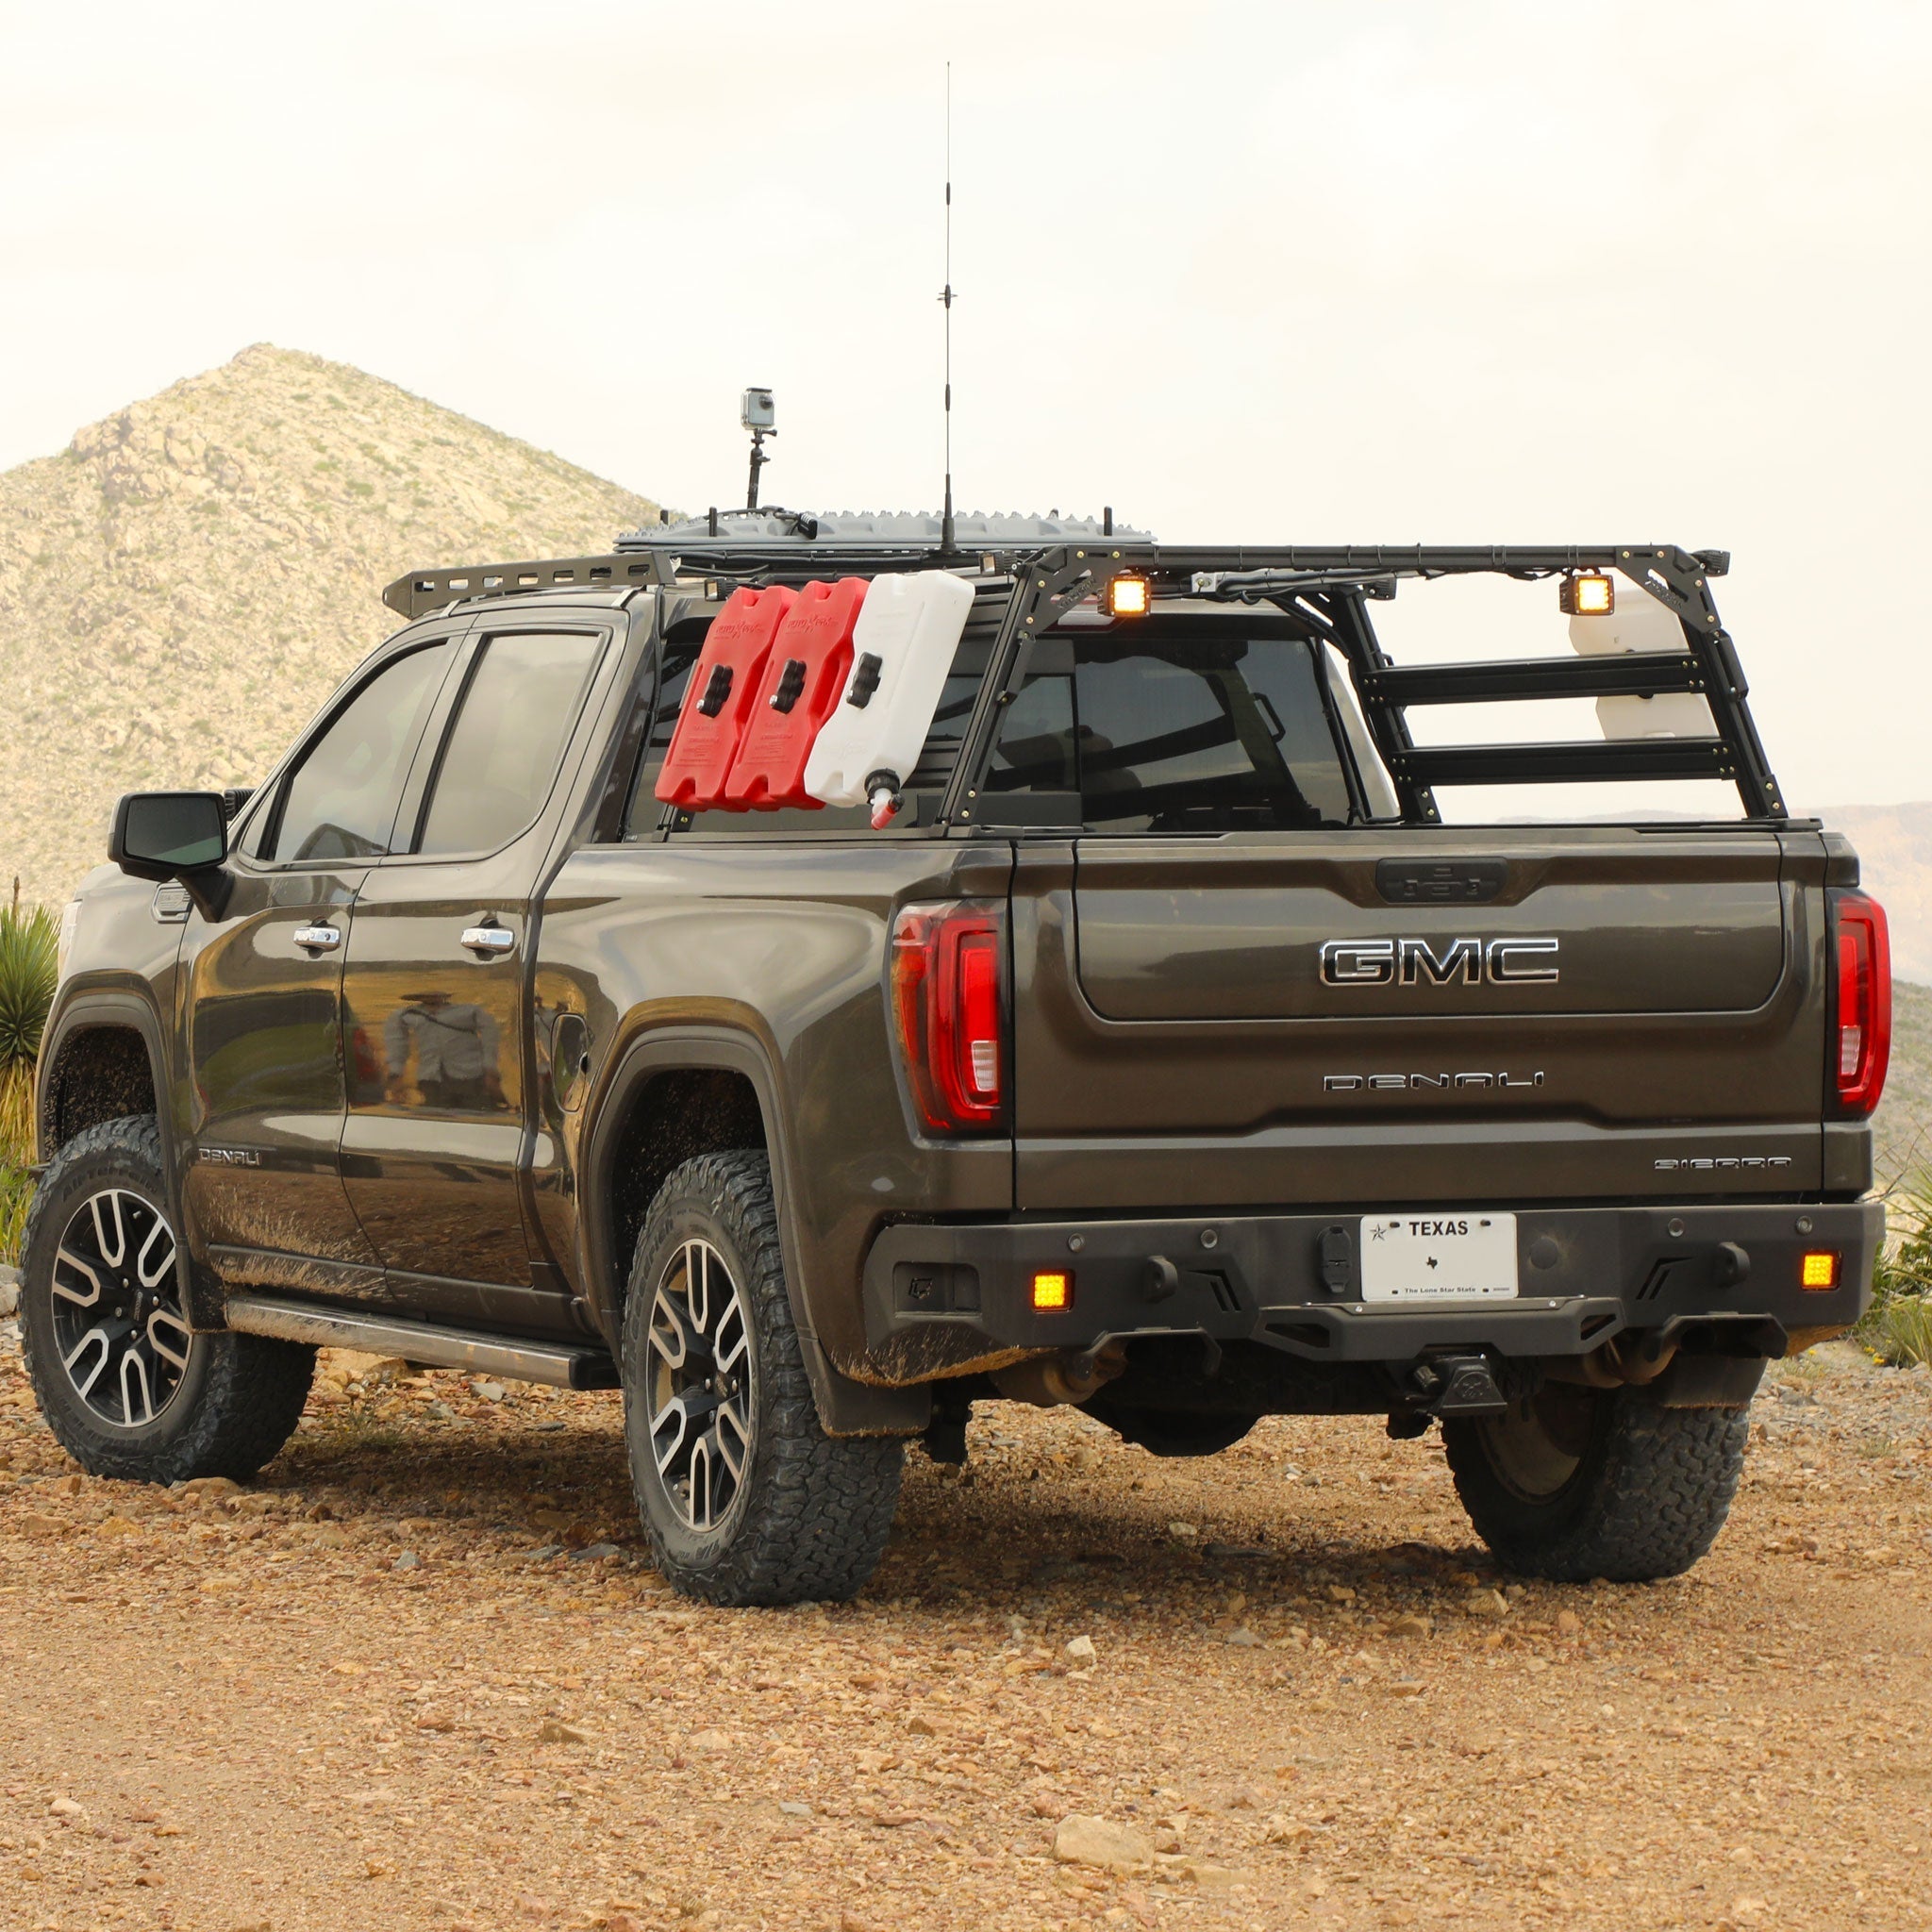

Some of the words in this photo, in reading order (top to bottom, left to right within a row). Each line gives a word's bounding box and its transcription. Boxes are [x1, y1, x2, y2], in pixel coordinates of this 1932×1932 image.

[1319, 937, 1559, 987] GMC
[1324, 1071, 1544, 1092] DENALI
[198, 1147, 262, 1166] DENALI
[1654, 1157, 1792, 1170] SIERRA
[1408, 1220, 1469, 1236] TEXAS
